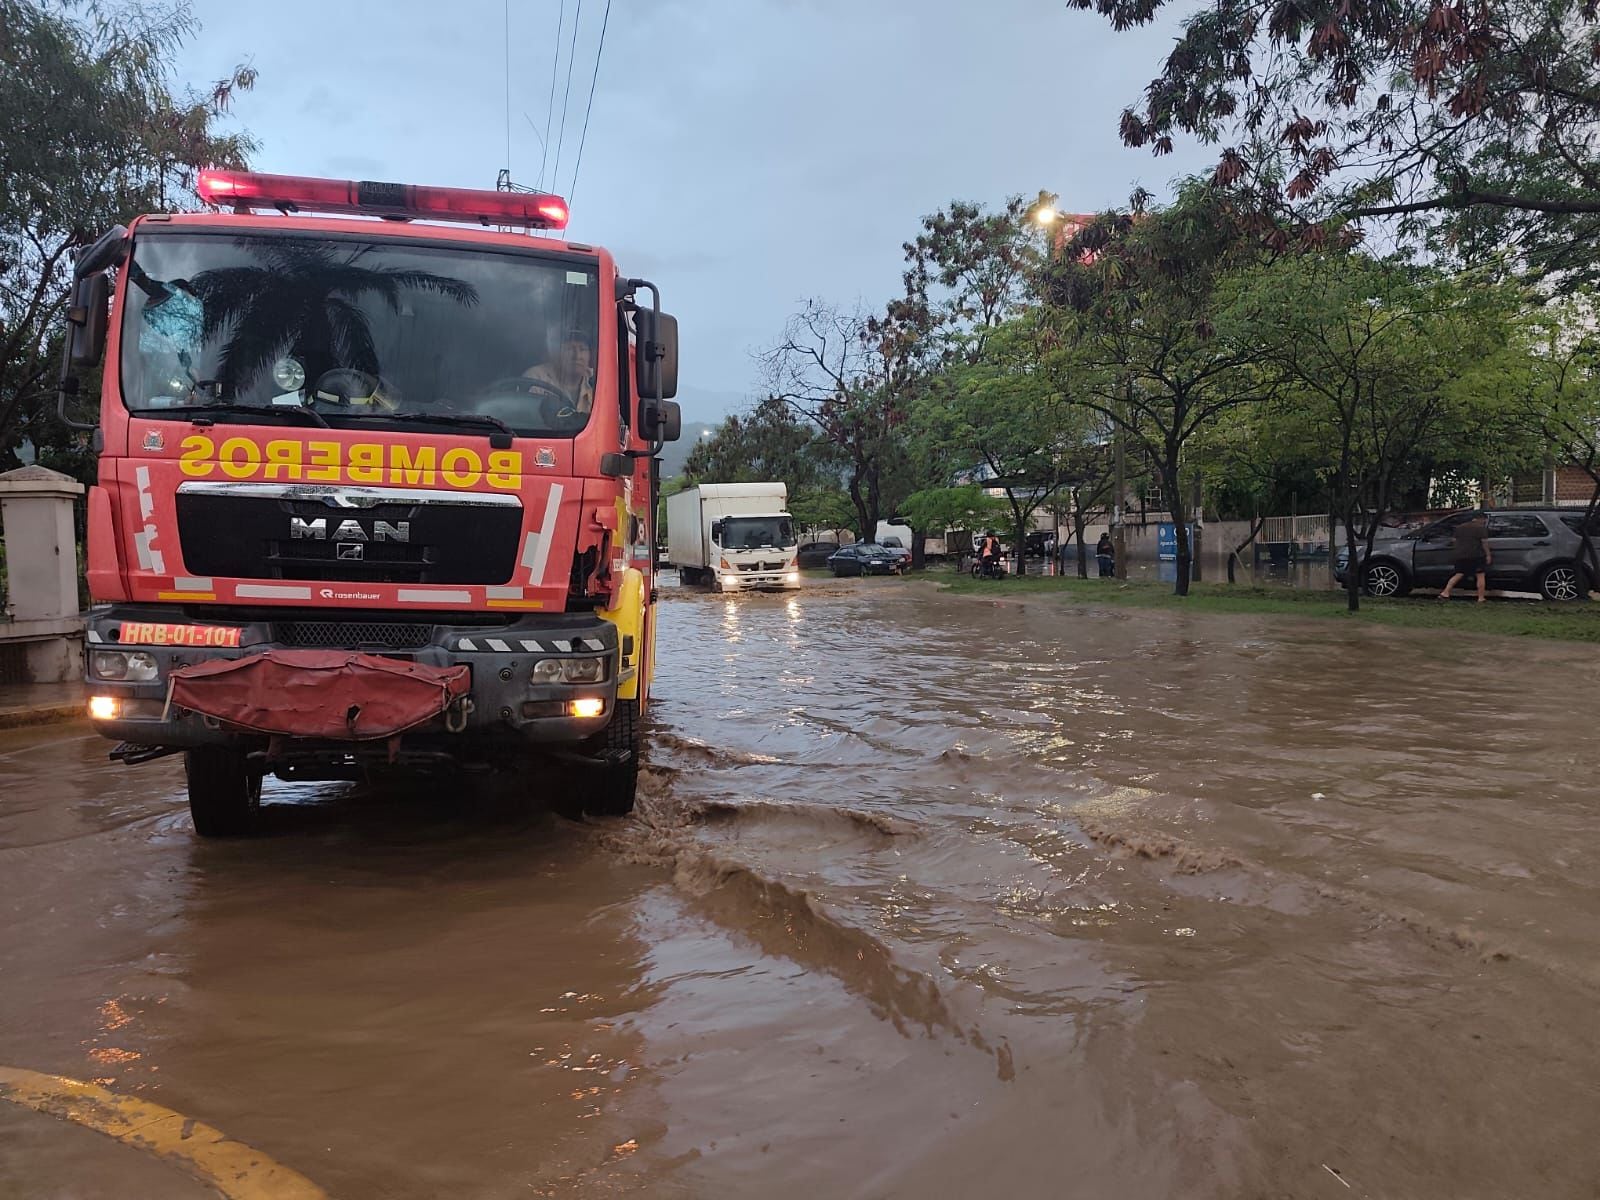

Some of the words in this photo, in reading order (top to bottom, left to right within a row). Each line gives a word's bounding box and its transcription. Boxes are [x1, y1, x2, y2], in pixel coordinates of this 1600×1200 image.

[291, 517, 410, 543] MAN
[335, 591, 381, 600] rosenbauer
[125, 623, 238, 646] HRB-01-101
